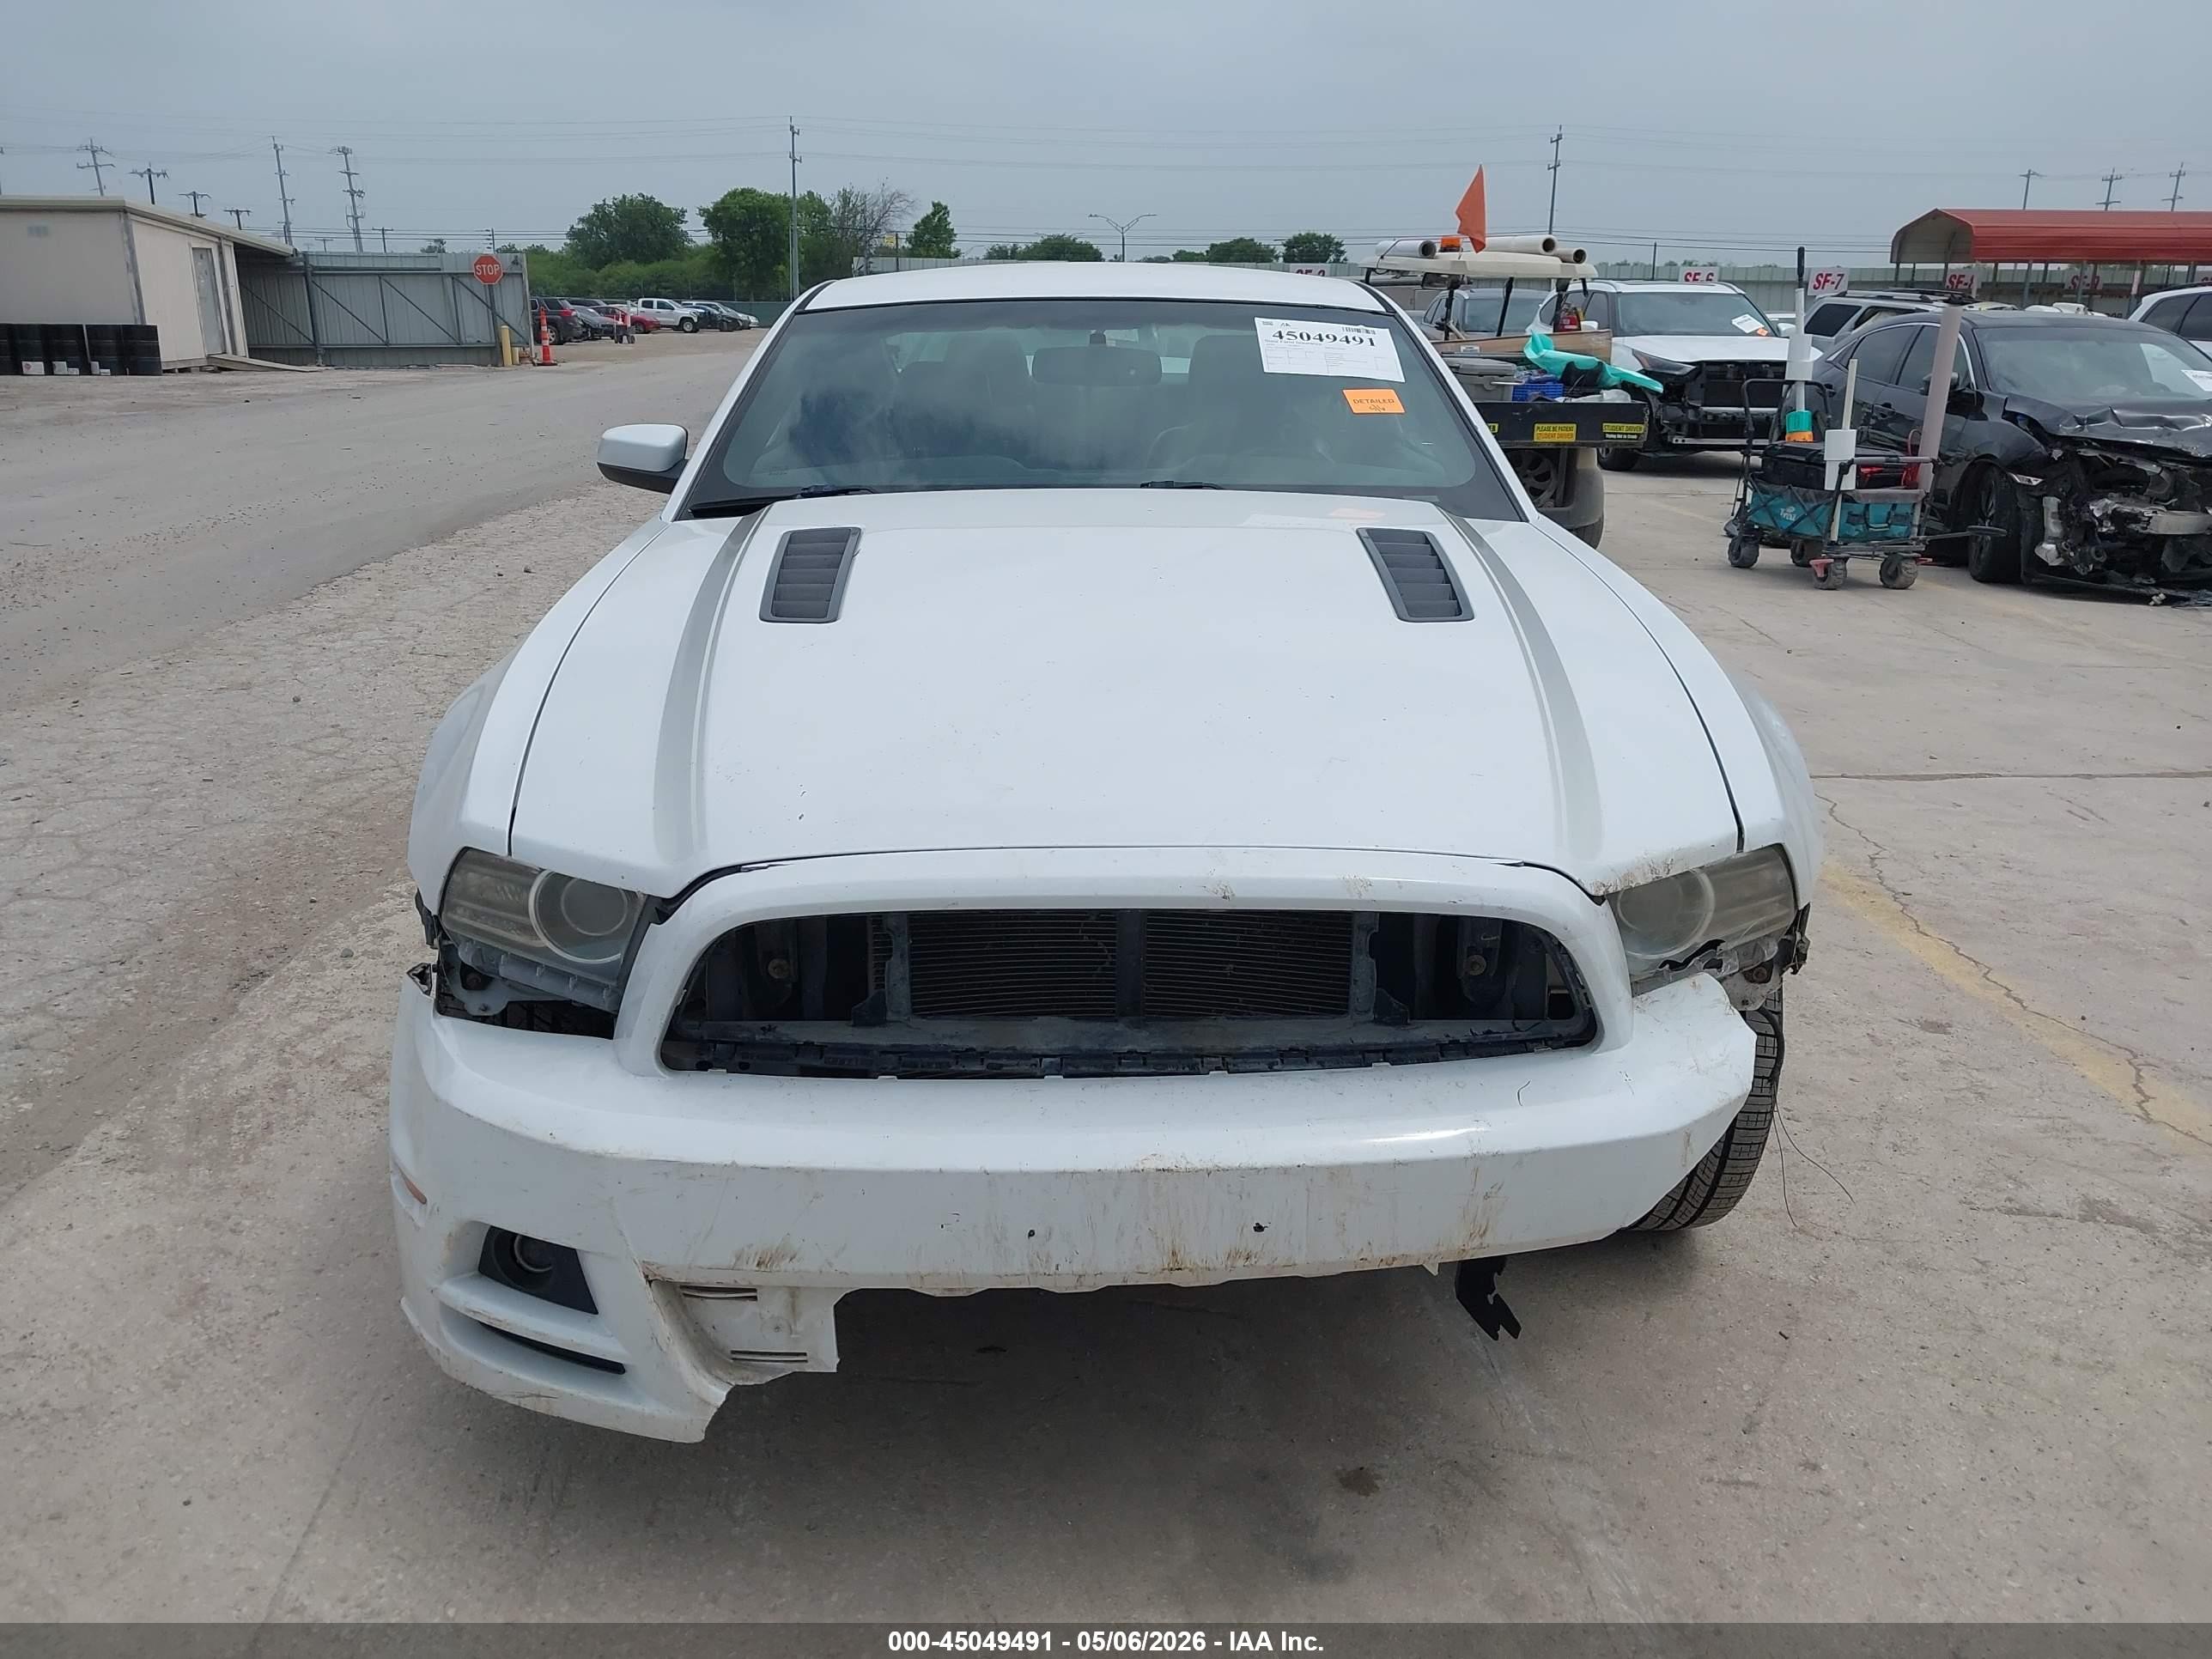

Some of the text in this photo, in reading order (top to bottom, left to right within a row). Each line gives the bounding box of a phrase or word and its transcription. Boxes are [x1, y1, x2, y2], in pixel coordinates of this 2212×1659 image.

[476, 264, 500, 276] STOP
[1813, 272, 1845, 290] SF-7
[1272, 330, 1376, 347] 45049491
